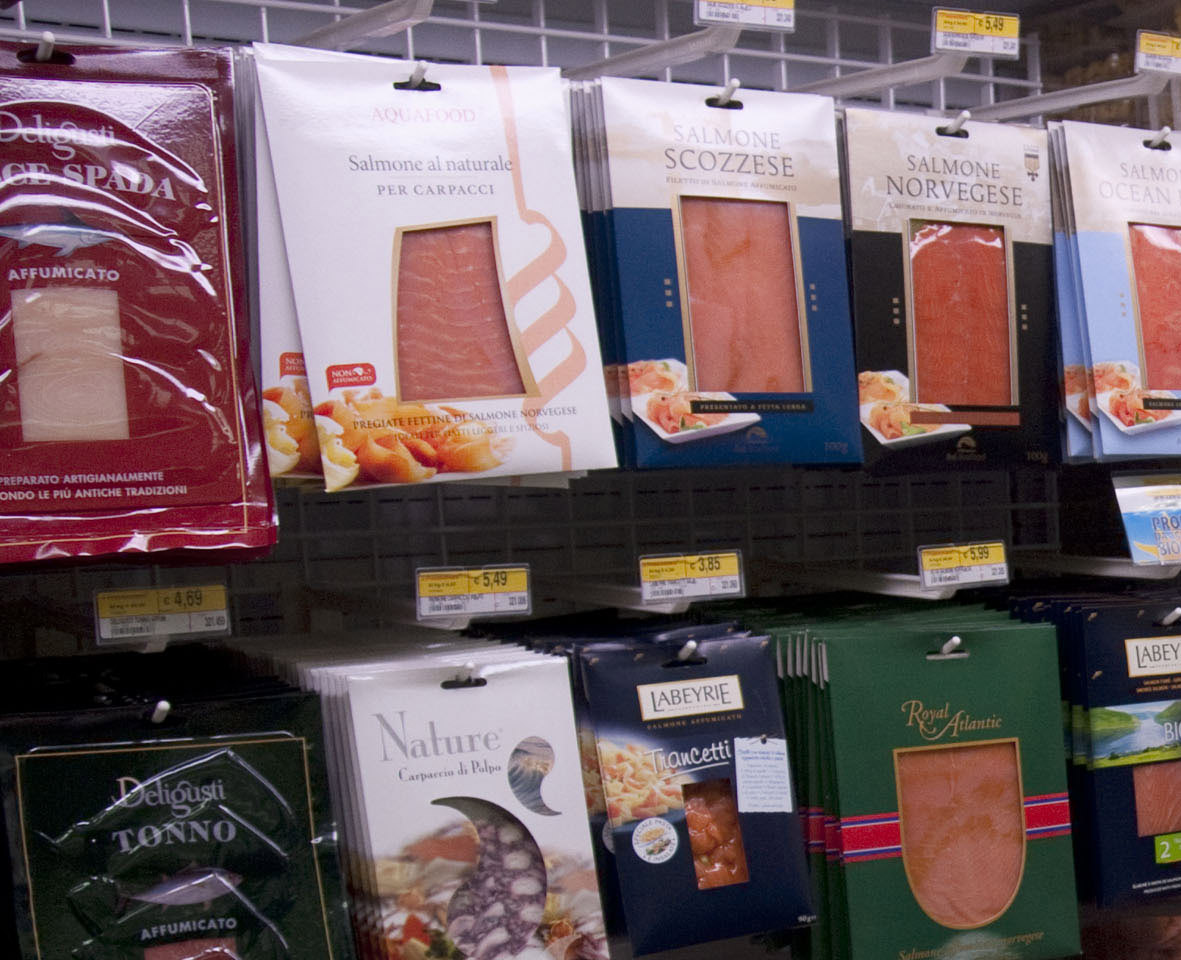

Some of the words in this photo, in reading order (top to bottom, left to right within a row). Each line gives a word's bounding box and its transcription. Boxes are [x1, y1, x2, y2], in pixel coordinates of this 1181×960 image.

[985, 16, 1004, 31] 5,49
[371, 106, 476, 124] AQUAFOOD
[673, 124, 782, 150] SALMONE
[349, 154, 423, 172] Salmone
[427, 155, 442, 172] al
[447, 156, 513, 172] naturale
[664, 148, 795, 178] SCOZZESE
[907, 154, 1000, 179] SALMONE
[63, 164, 176, 201] SPADA
[377, 184, 408, 196] PER
[413, 184, 495, 196] CARPACCI
[886, 175, 1023, 207] NORVEGESE
[1099, 181, 1171, 206] OCEAN
[8, 267, 120, 281] AFFUMICATO
[352, 417, 402, 430] PREGIATE
[406, 414, 451, 427] FETTINE
[469, 410, 518, 422] SALMONE
[520, 405, 578, 419] NORVEGESE
[63, 471, 164, 485] ARTIGIANALMENTE
[38, 490, 50, 500] LE
[75, 488, 122, 498] ANTICHE
[125, 485, 188, 497] TRADIZIONI
[698, 556, 721, 572] 3,85
[970, 546, 989, 560] 5,99
[482, 571, 508, 588] 5,49
[174, 590, 204, 607] 4,69
[650, 682, 732, 713] LABEYRIE
[647, 719, 688, 731] SALMONE
[690, 713, 742, 725] AFFUMICATO
[901, 699, 950, 740] Royal
[947, 710, 1003, 737] Atlantic
[372, 710, 502, 762] Nature
[398, 766, 455, 784] Carpaccio
[457, 763, 469, 776] di
[471, 758, 502, 775] Polpo
[112, 776, 227, 818] Deligusti
[113, 820, 236, 853] TONNO
[1159, 840, 1171, 859] 2
[140, 917, 238, 941] AFFUMICATO
